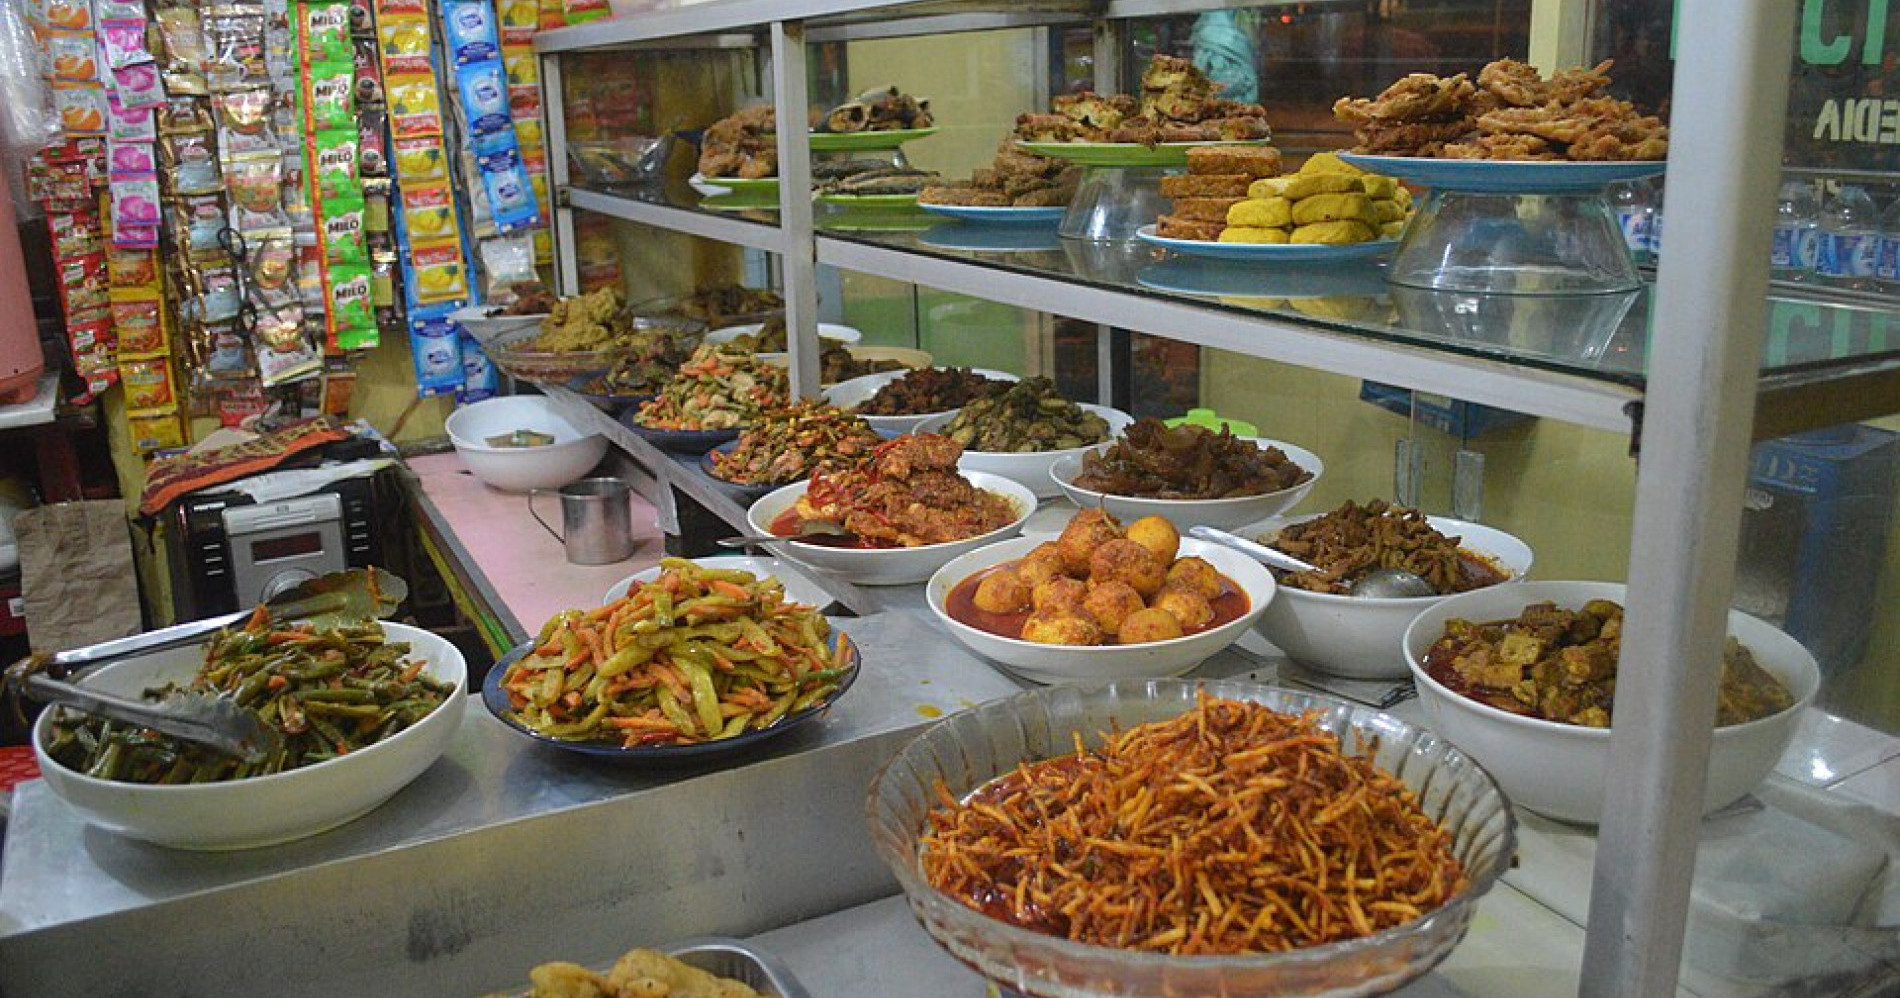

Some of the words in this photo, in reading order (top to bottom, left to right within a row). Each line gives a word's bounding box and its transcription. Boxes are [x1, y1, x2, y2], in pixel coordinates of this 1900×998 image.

[320, 150, 353, 166] MILO
[328, 220, 359, 234] MILO
[336, 285, 366, 300] MILO
